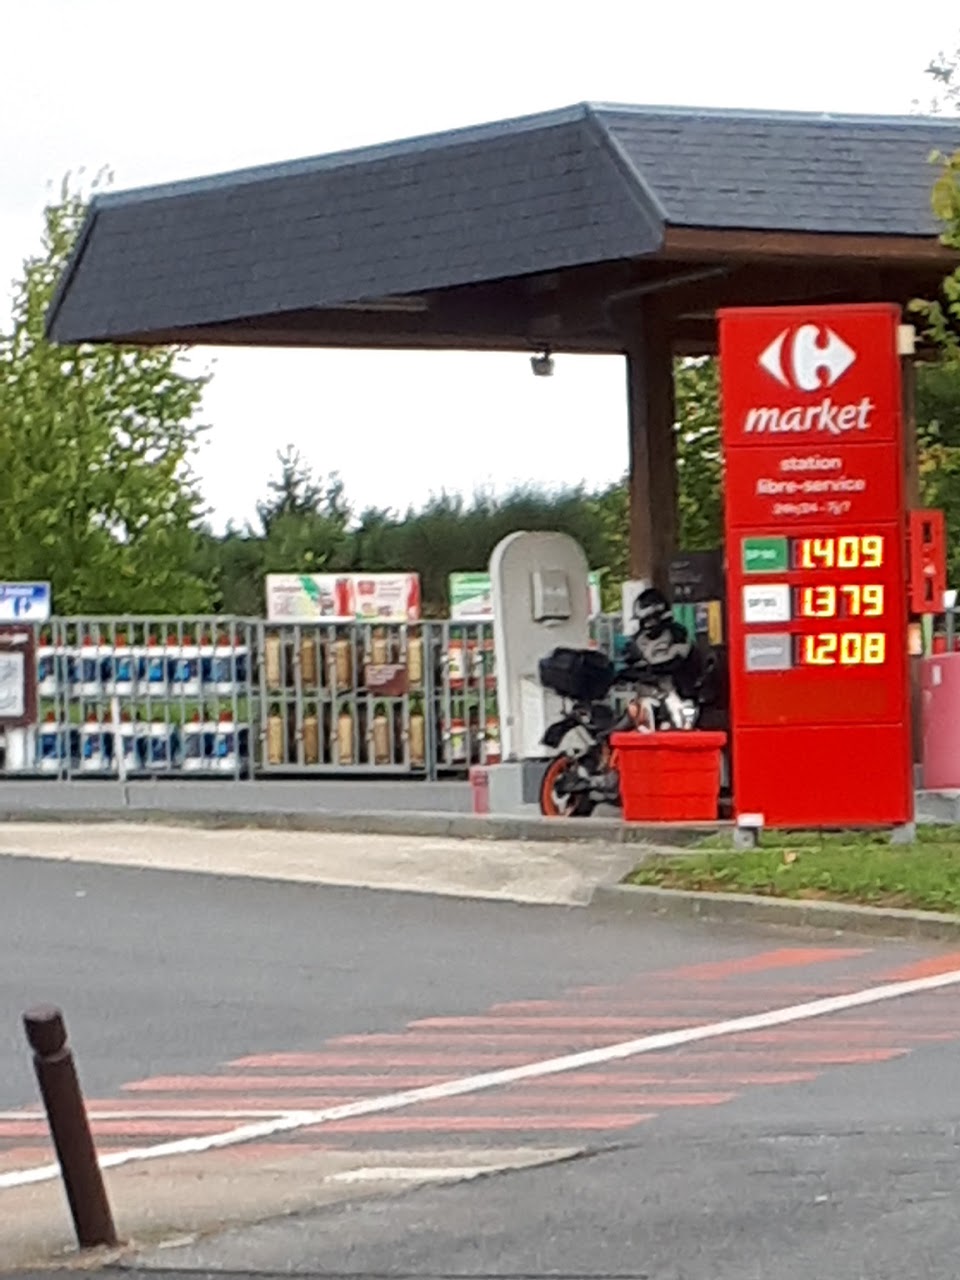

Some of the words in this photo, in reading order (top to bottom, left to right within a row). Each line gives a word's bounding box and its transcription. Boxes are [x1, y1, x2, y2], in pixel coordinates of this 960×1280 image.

[743, 397, 877, 435] market
[780, 454, 843, 472] station
[755, 475, 866, 496] libre-service
